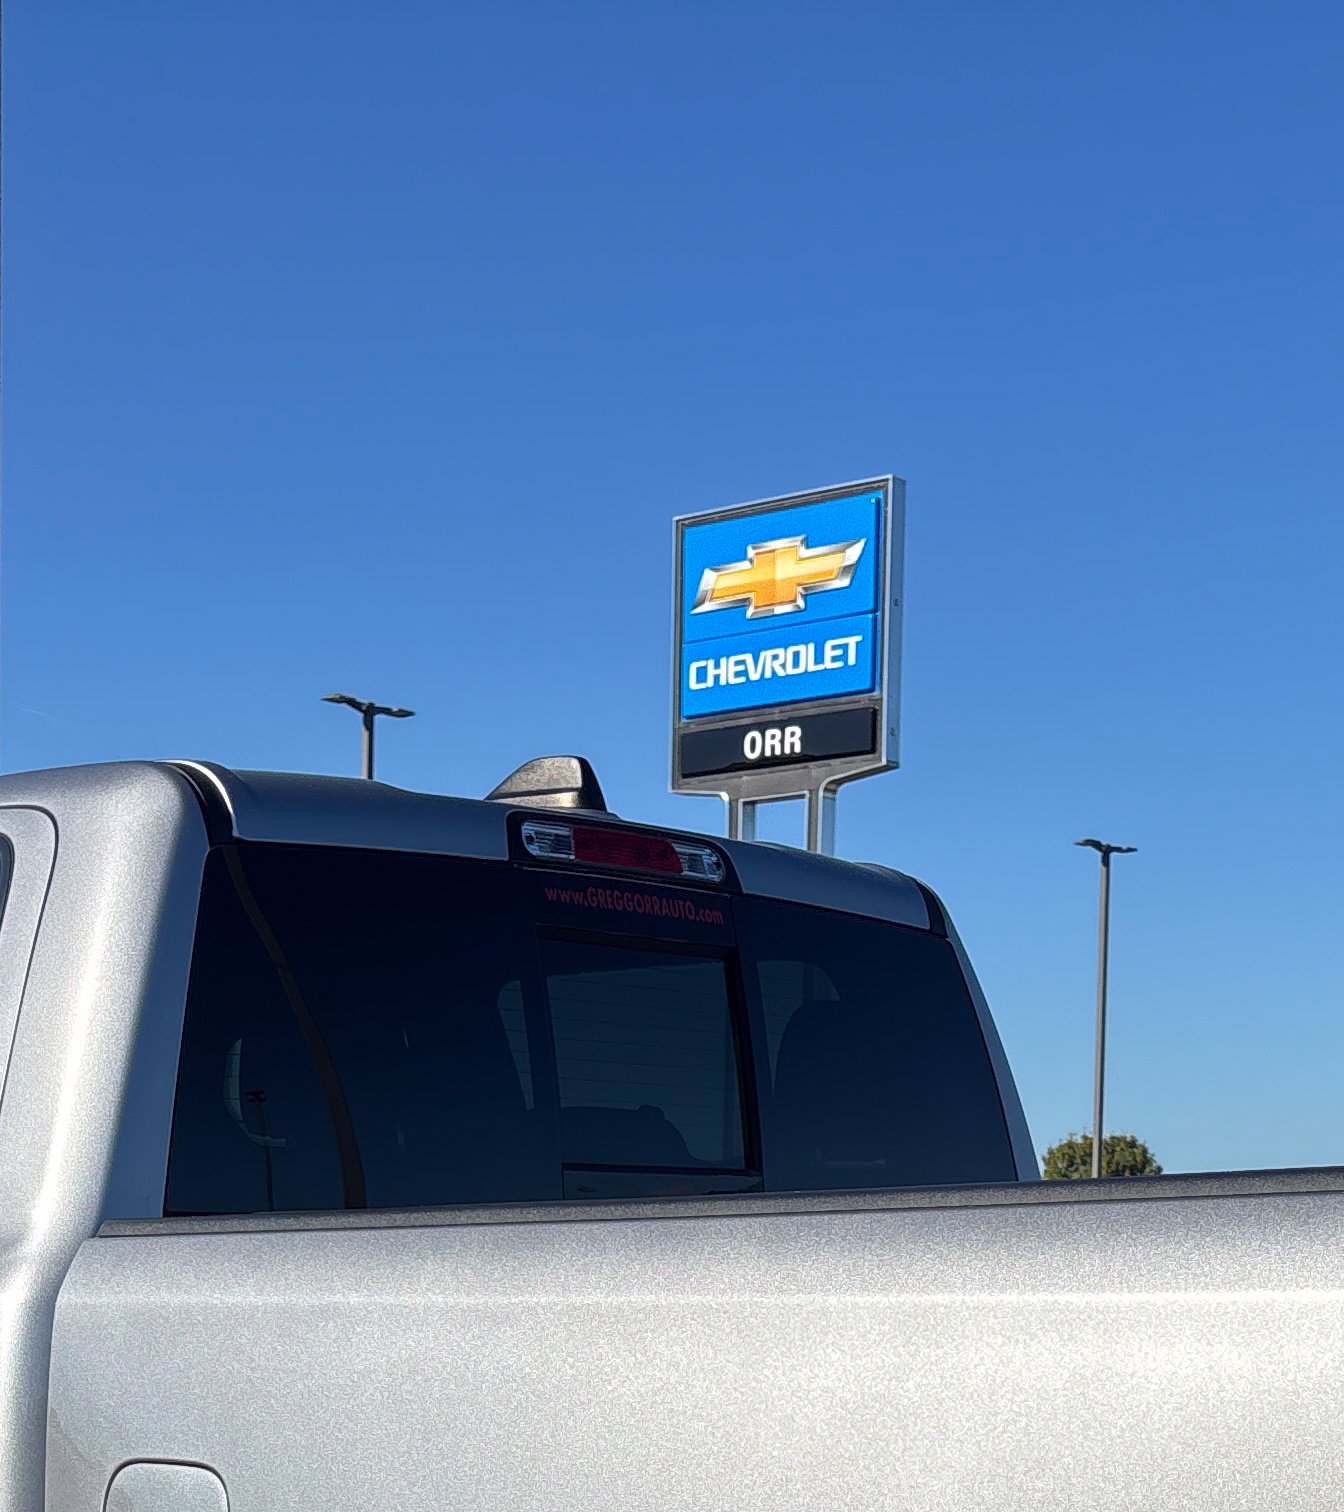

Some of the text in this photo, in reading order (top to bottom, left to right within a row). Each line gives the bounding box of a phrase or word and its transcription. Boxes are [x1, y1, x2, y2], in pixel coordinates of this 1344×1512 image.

[689, 635, 862, 691] CHEVROLET
[743, 725, 802, 760] ORR
[544, 886, 725, 926] www.GREGGORRAUTO.com
